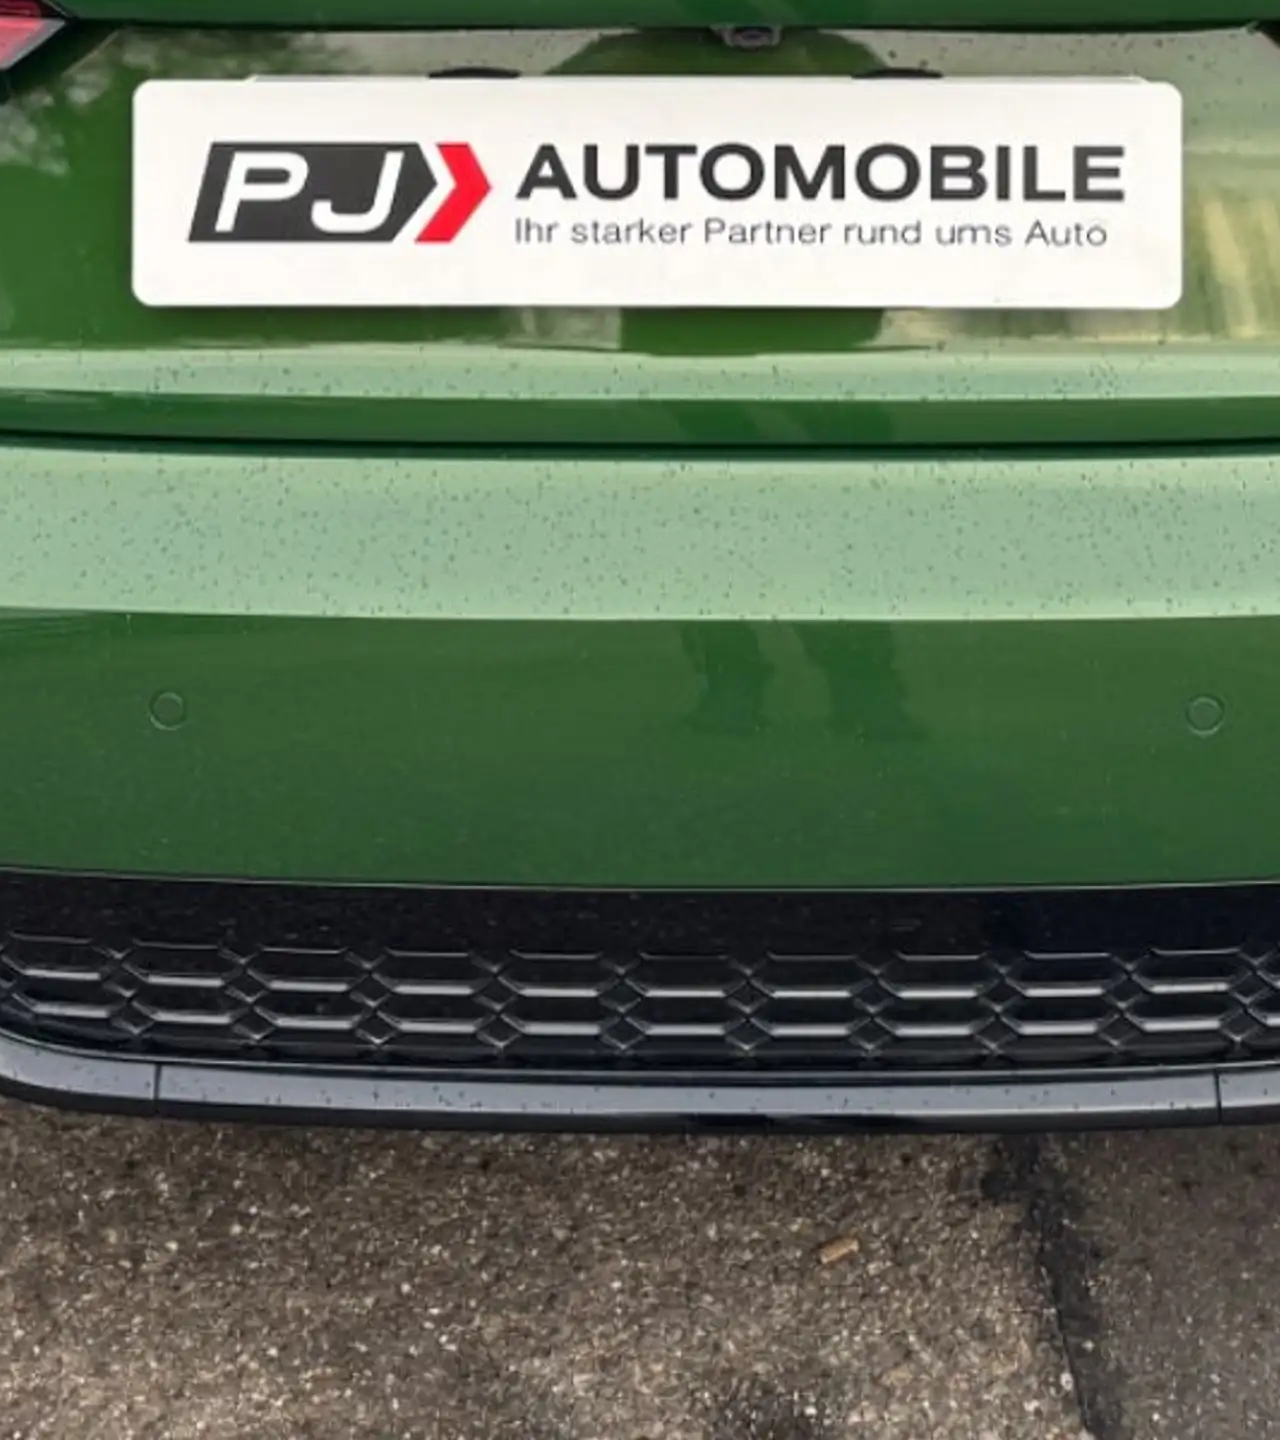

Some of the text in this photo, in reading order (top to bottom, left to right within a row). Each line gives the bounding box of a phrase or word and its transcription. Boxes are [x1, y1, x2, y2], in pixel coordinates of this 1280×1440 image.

[214, 144, 1125, 233] PJ AUTOMOBILE
[515, 217, 1108, 246] Ihr starker Partner rund ums Auto
